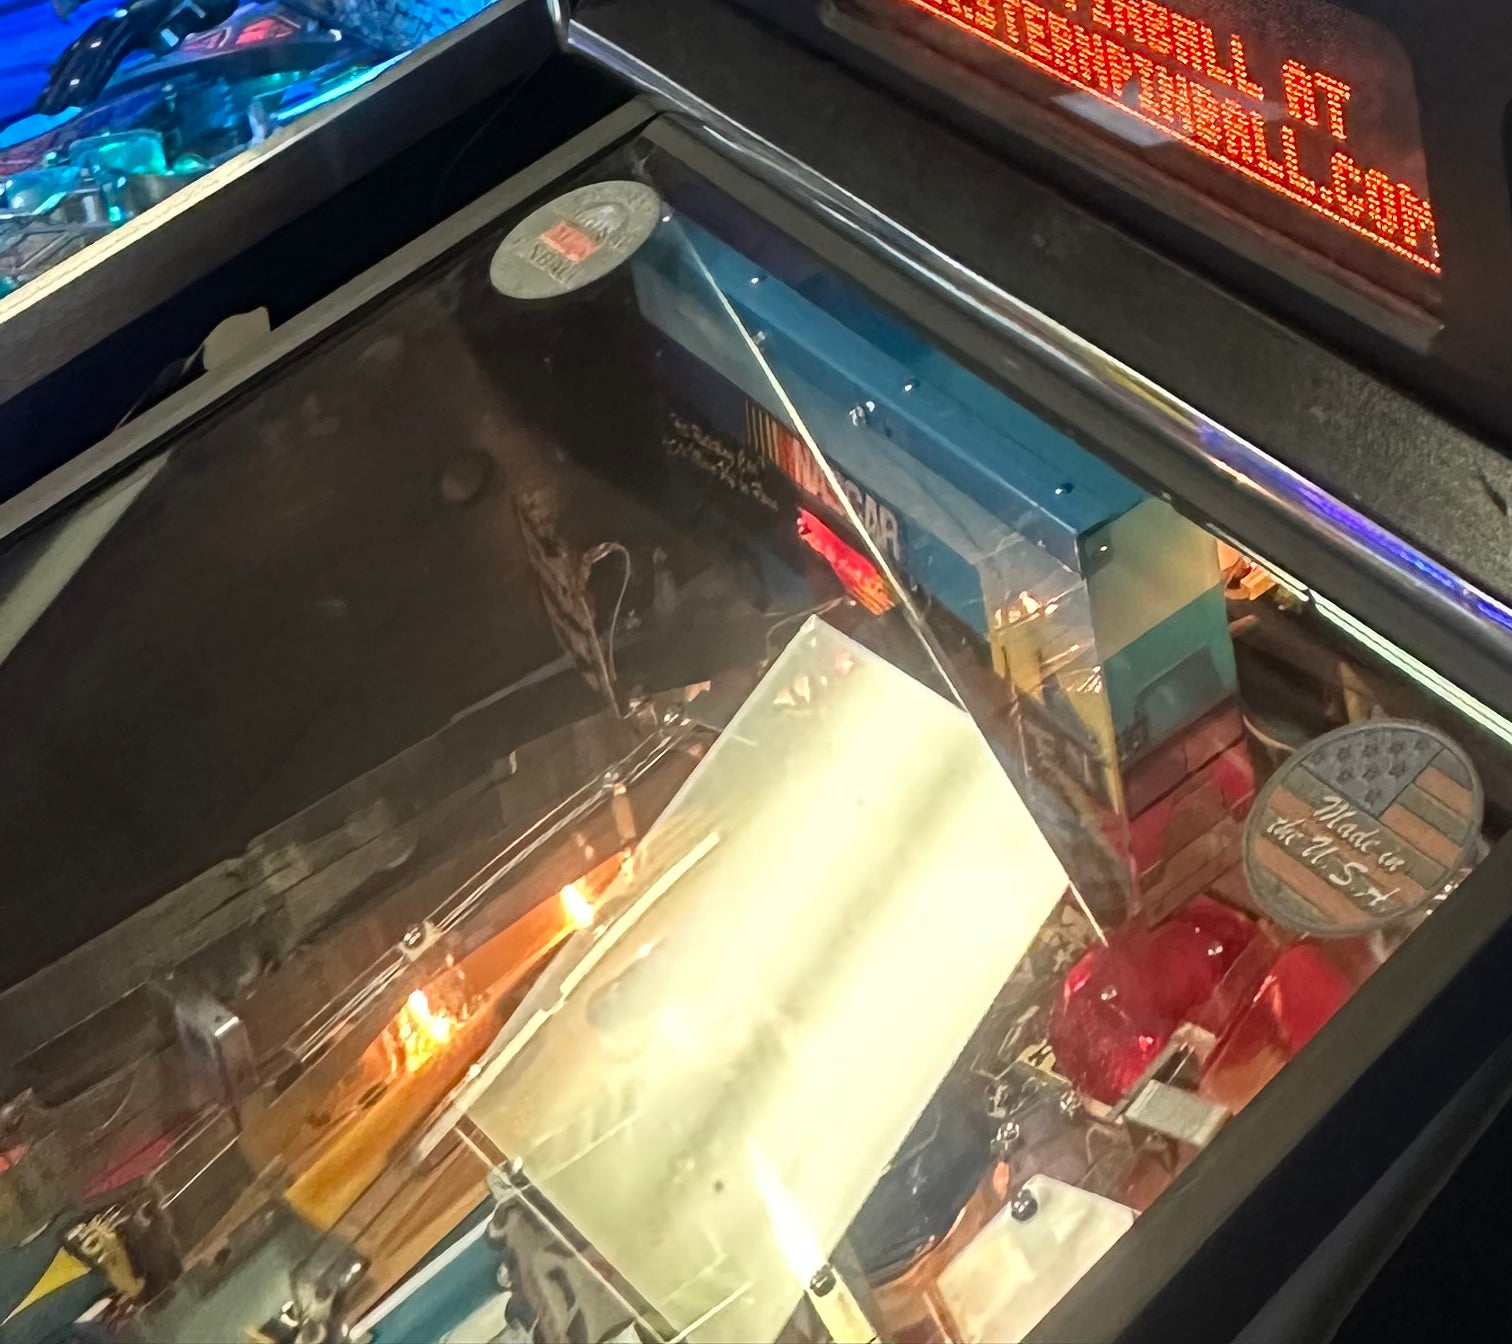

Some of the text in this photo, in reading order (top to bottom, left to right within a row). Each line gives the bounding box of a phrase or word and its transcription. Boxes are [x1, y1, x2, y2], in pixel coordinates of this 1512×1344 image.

[1281, 57, 1351, 141] AT
[1266, 816, 1307, 846] the
[1312, 795, 1405, 872] Made in
